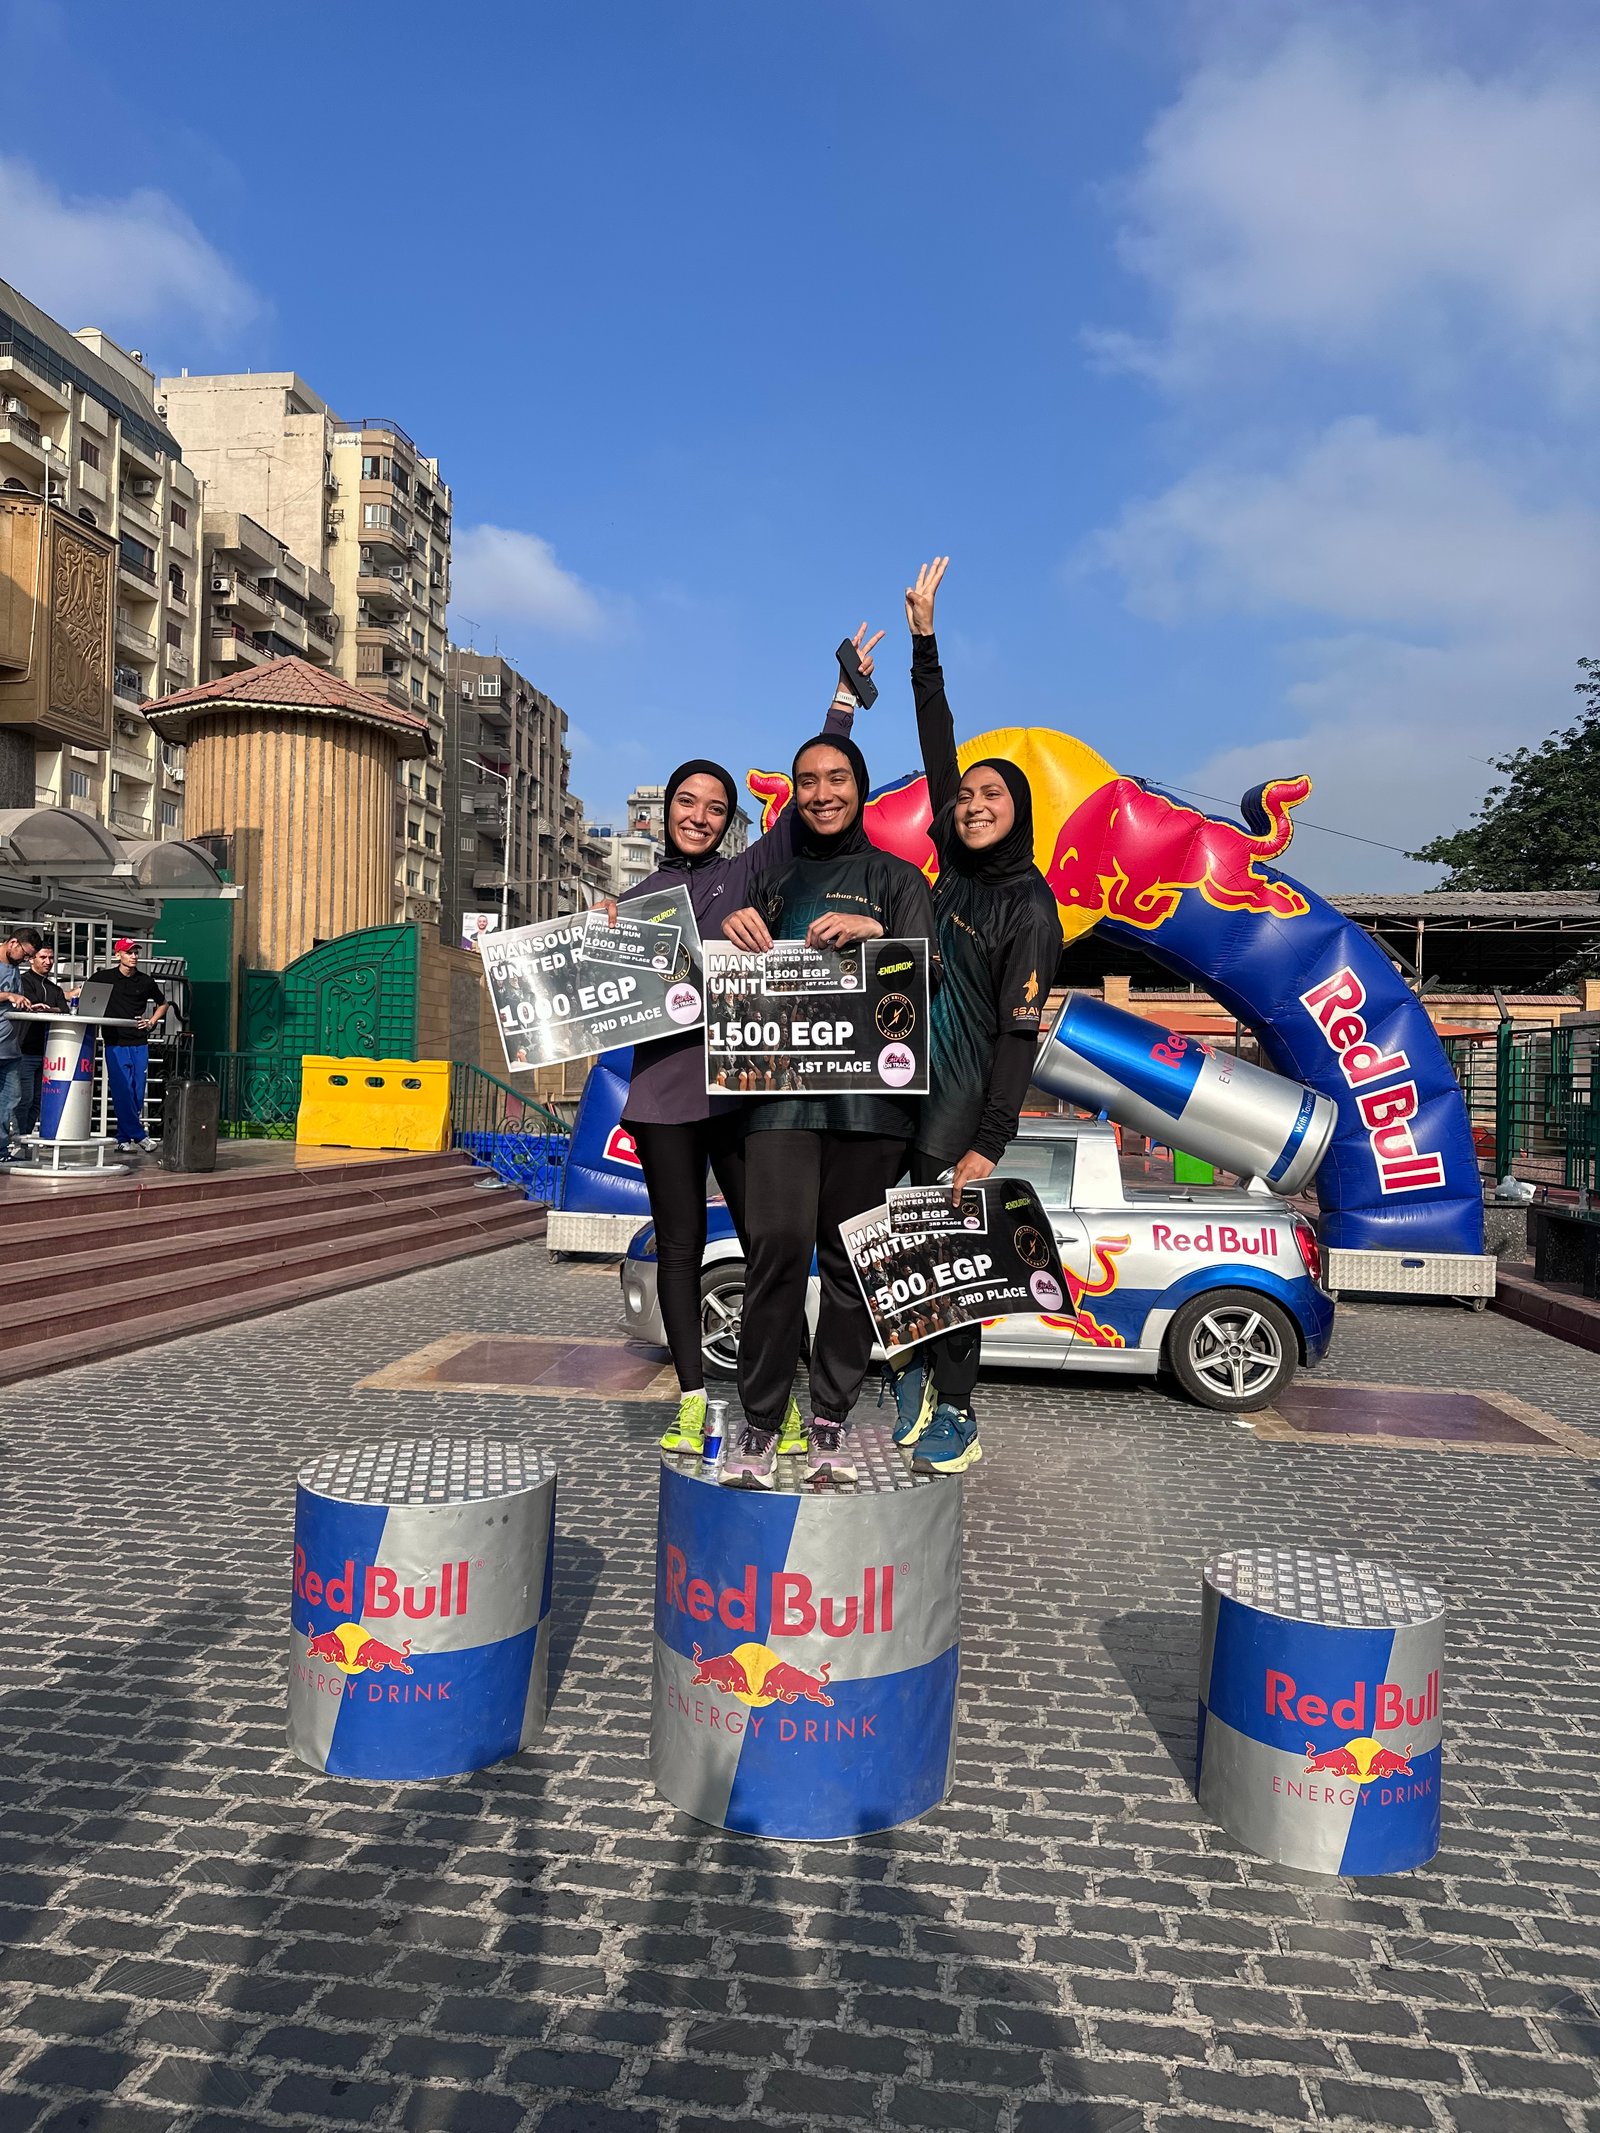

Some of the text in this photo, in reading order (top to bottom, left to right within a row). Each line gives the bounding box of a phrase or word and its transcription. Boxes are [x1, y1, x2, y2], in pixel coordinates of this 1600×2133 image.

[589, 924, 621, 935] UNITED
[590, 918, 638, 931] MANOURA
[487, 926, 584, 961] MANSOUR
[585, 937, 645, 953] 1000 EGP
[492, 952, 566, 981] UNITED
[709, 955, 765, 972] MANS
[766, 955, 801, 963] UNITED
[878, 961, 913, 976] ENDUROX
[766, 968, 831, 979] 1500 EGP
[710, 978, 764, 995] UNIT
[499, 976, 637, 1028] 1000 EGP
[591, 1006, 663, 1035] 2ND PLACE
[708, 1021, 855, 1047] 1500 EGP
[1150, 1030, 1189, 1071] Re
[797, 1061, 872, 1073] 1ST PLACE
[1302, 969, 1443, 1192] Red Bull
[1293, 1115, 1309, 1133] With
[890, 1191, 941, 1200] MANSOURA
[890, 1198, 924, 1207] UNITED
[893, 1209, 950, 1222] 500 EGP
[855, 1233, 927, 1268] UNITED
[1152, 1224, 1278, 1257] Red Bull
[875, 1254, 993, 1311] 500 EGP
[957, 1286, 1028, 1307] 3RD PLACE
[293, 1543, 470, 1620] Red Bull
[665, 1543, 895, 1638] Red Bull
[368, 1681, 452, 1704] DRINK
[1265, 1668, 1440, 1731] Red Bull
[667, 1686, 878, 1743] ENERGY DRINK
[1272, 1775, 1433, 1806] ENERGY DRINK
